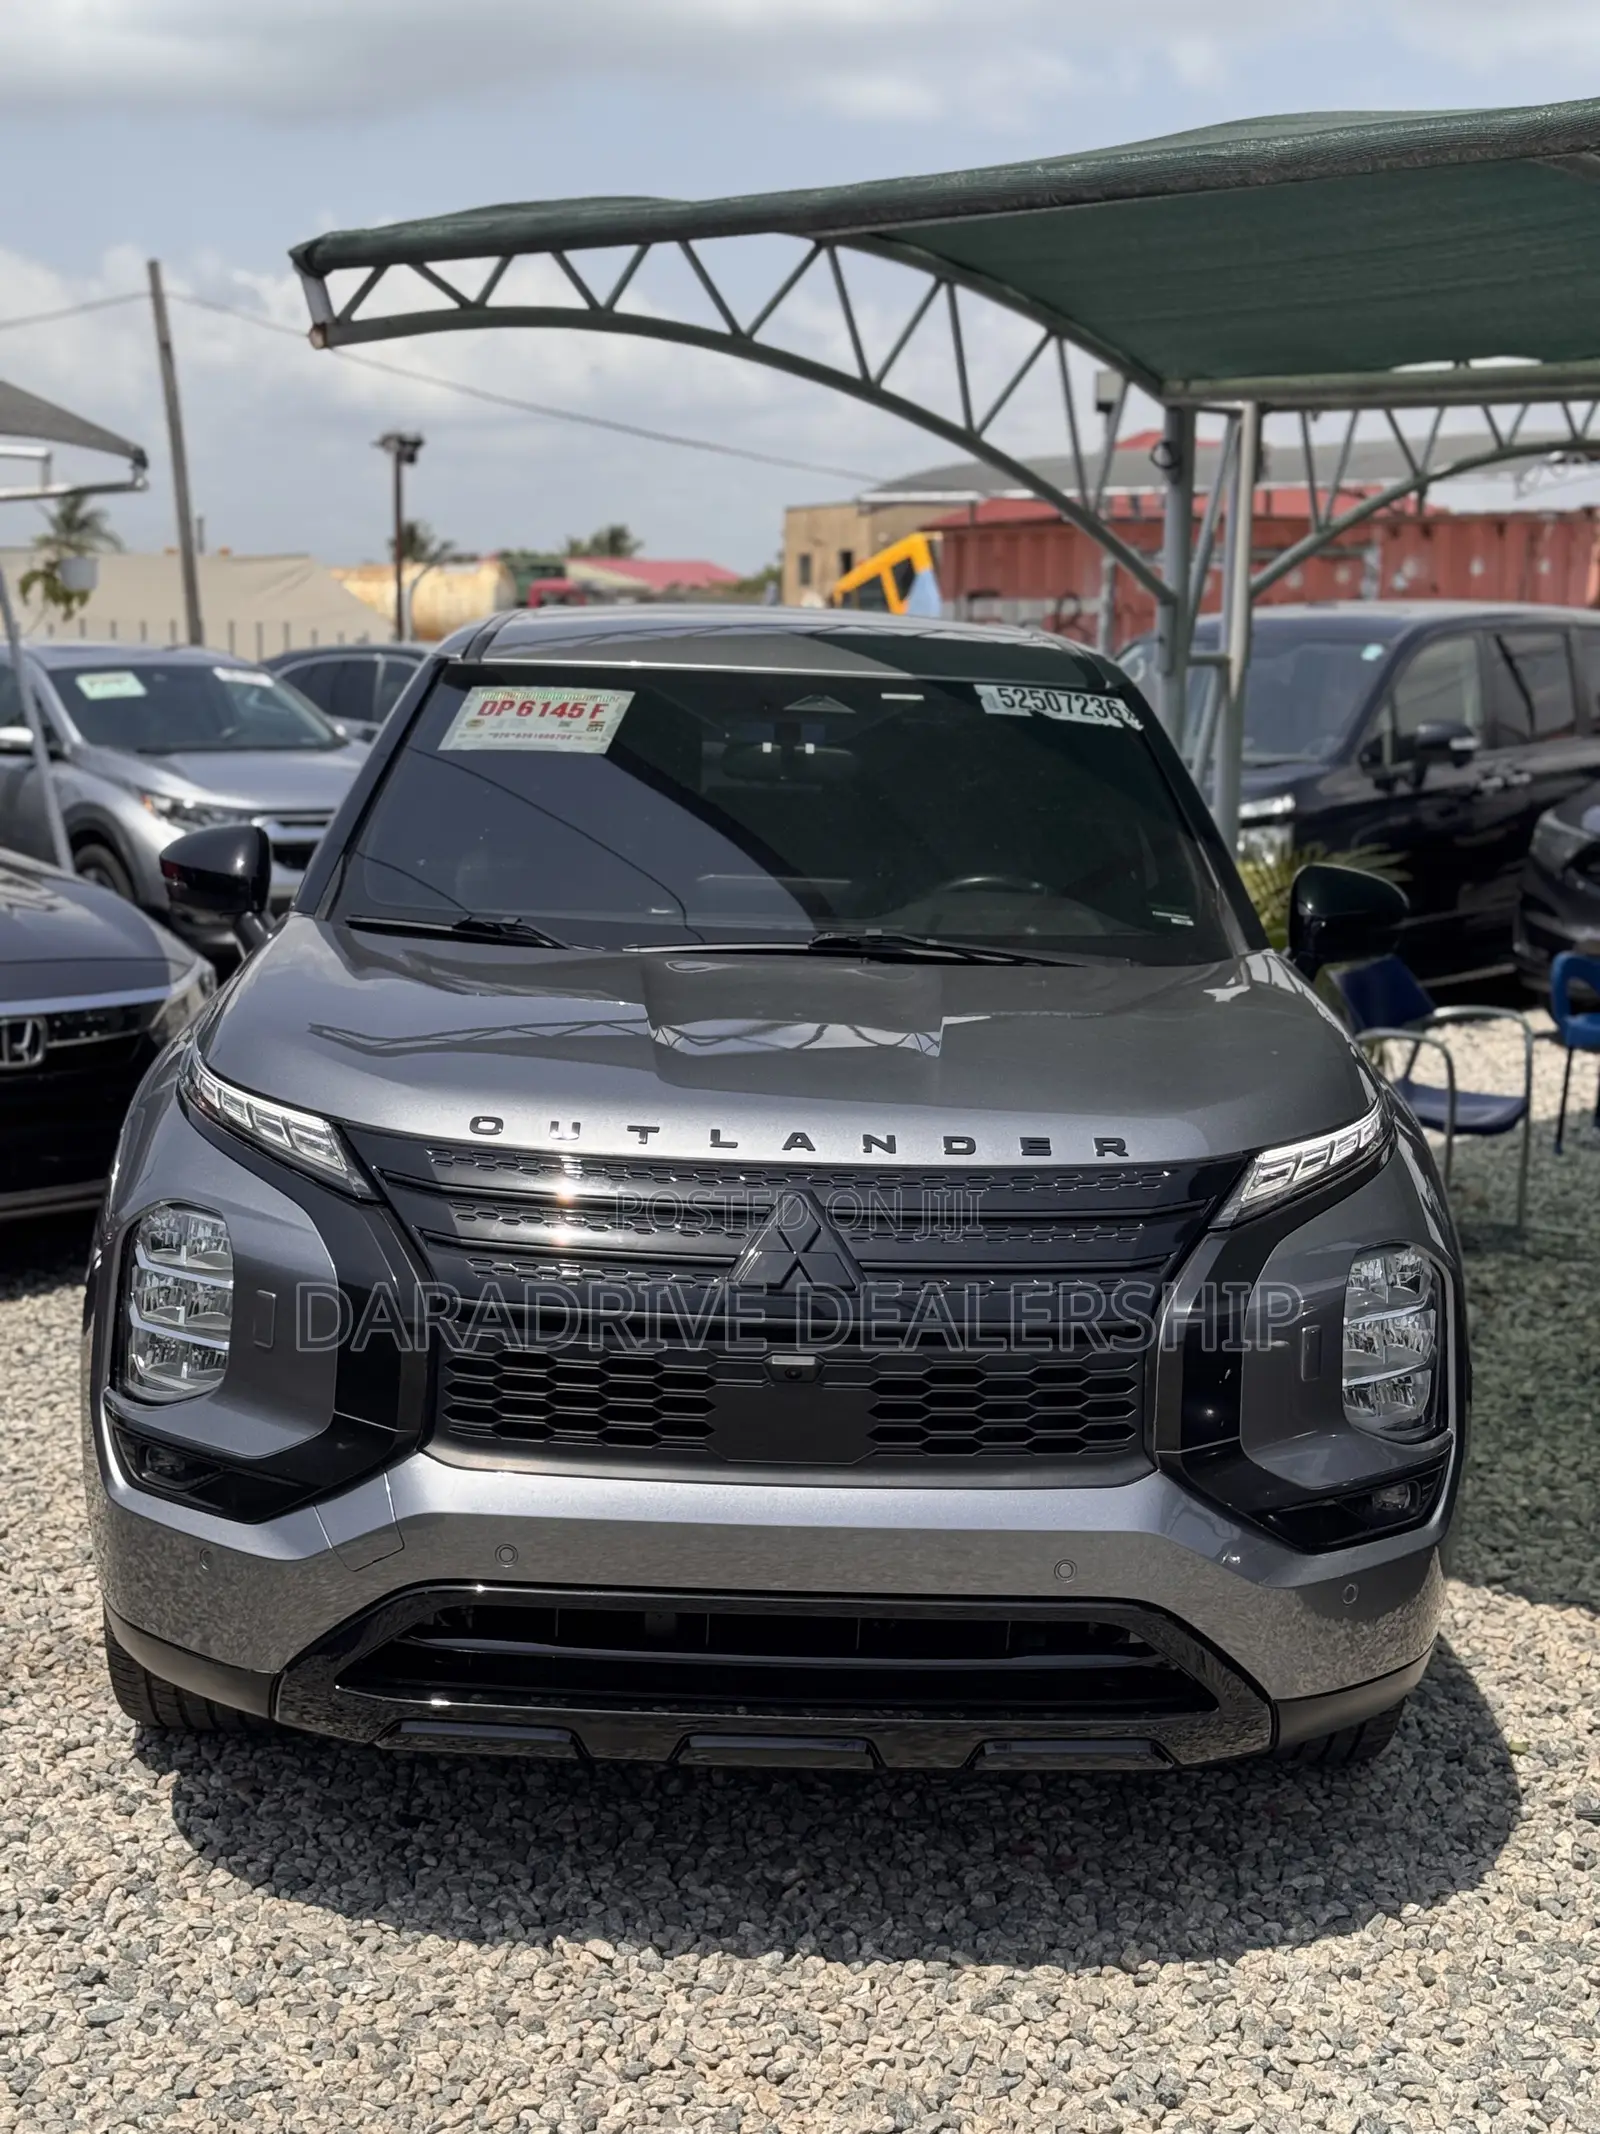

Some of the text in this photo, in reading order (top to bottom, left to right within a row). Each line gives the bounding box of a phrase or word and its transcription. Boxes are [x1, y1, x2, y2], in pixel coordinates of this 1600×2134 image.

[476, 699, 609, 720] DP 6145 F
[468, 1115, 1130, 1158] OUTLANDER
